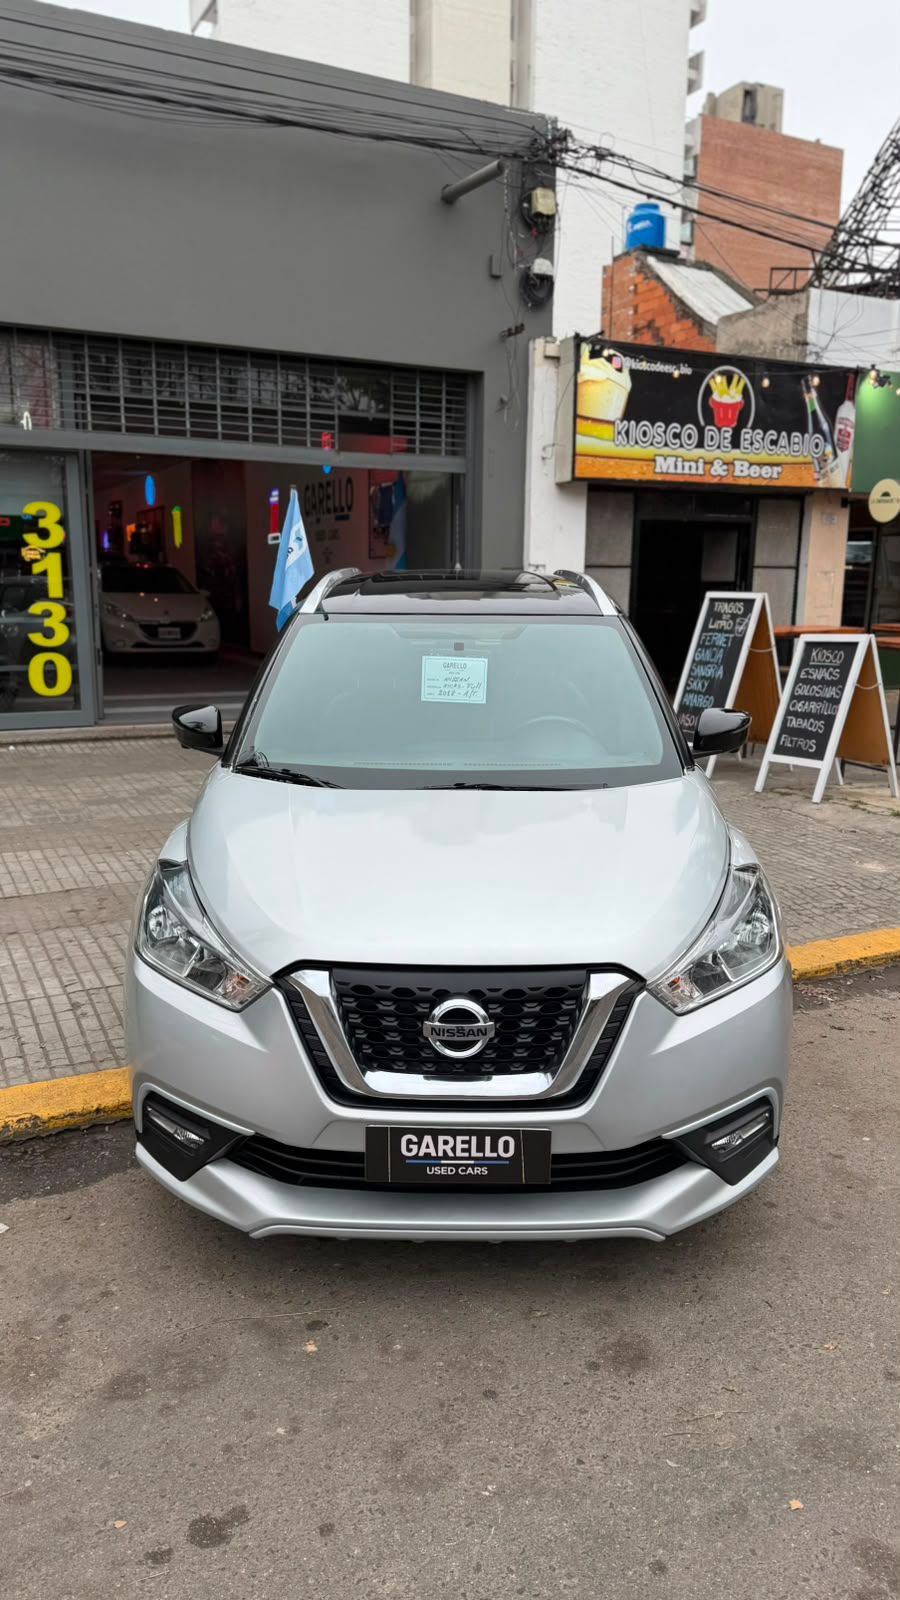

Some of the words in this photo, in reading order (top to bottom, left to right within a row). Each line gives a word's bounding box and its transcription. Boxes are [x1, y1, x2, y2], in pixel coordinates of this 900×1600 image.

[614, 419, 699, 450] KIOSCO
[703, 425, 733, 452] DE
[740, 428, 825, 458] ESCABIO
[654, 455, 705, 475] Mini
[710, 459, 728, 477] &
[733, 459, 782, 479] Beer
[714, 601, 744, 614] TRAGOS
[700, 632, 735, 648] FERNET
[800, 666, 840, 681] ESNACS
[786, 715, 825, 734] TABACOS
[430, 1027, 488, 1038] NISSAN
[400, 1134, 515, 1158] GARELLO
[426, 1166, 456, 1175] USED
[458, 1166, 488, 1175] CARS
